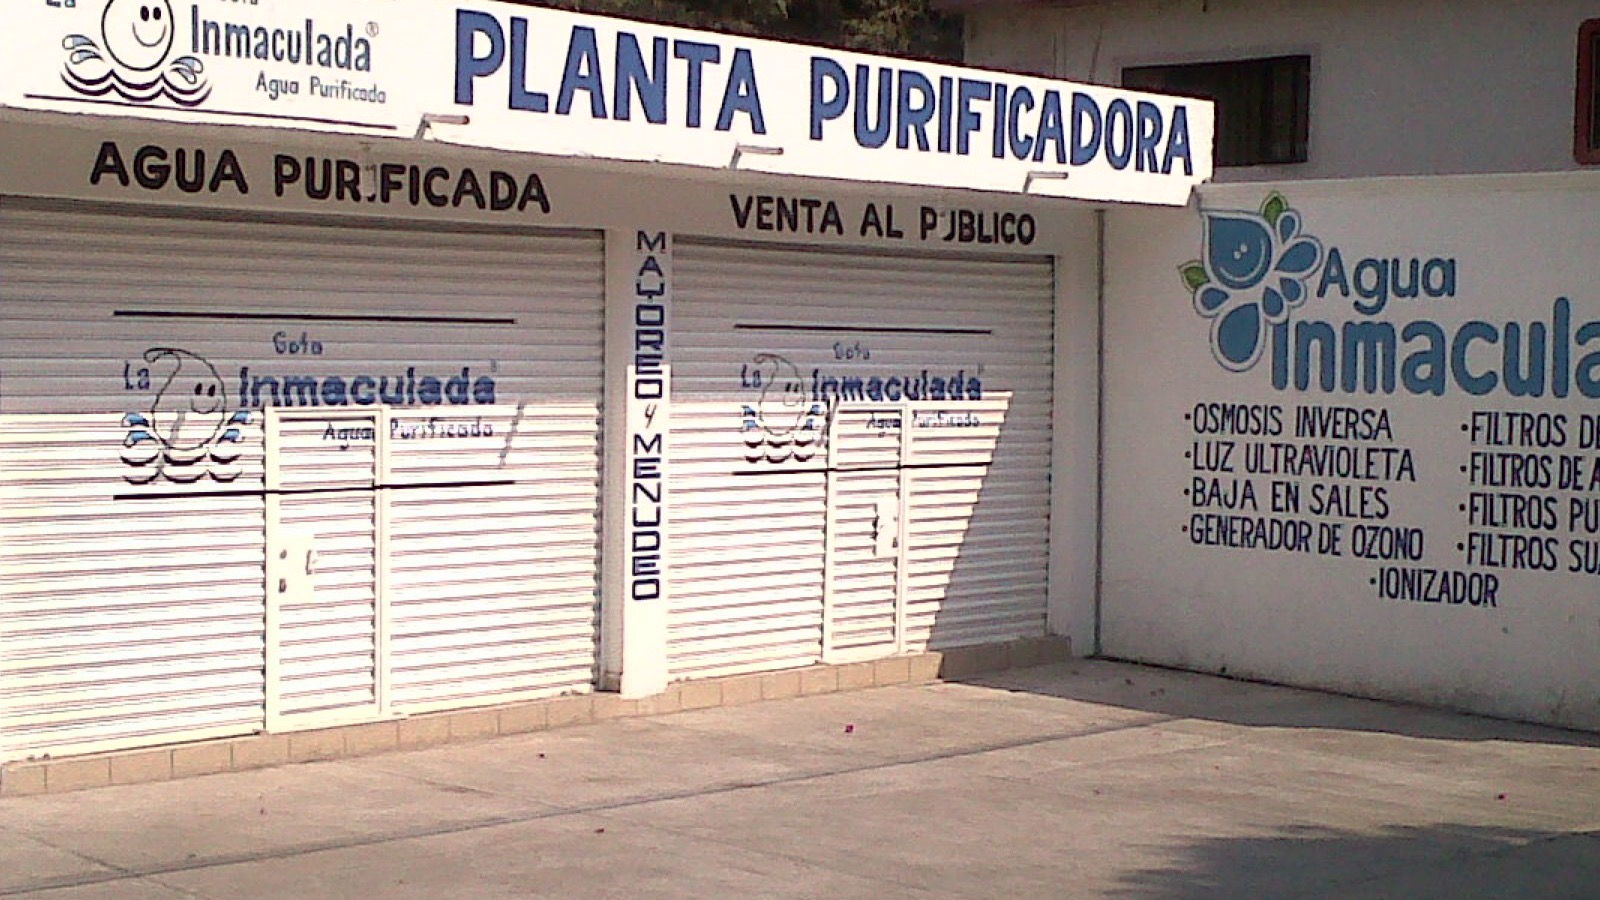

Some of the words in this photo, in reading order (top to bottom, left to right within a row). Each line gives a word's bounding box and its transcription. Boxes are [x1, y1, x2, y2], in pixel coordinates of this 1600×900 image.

[255, 70, 300, 100] Agua
[309, 76, 387, 104] Purificada
[454, 8, 767, 136] PLANTA
[810, 56, 1194, 176] PURIFICADORA
[91, 141, 248, 194] AGUA
[274, 154, 551, 213] PURFICADA
[730, 194, 844, 235] VENTA
[860, 202, 904, 238] AL
[1316, 247, 1456, 315] Agua
[634, 230, 667, 399] MAYOREO
[273, 331, 324, 355] Gota
[240, 366, 496, 408] Inmaculada
[811, 368, 982, 402] Inmaculada
[323, 422, 375, 449] Agua
[1193, 403, 1282, 437] OSMOSIS
[1296, 406, 1393, 442] INVERSA
[1472, 411, 1567, 447] FILTROS
[1580, 414, 1600, 449] D
[1193, 442, 1235, 473] LUZ
[1246, 443, 1415, 482] ULTRAVIOLETA
[1470, 452, 1552, 488] FILTROS
[1559, 454, 1584, 490] DE
[631, 433, 663, 601] MENUDEO
[1192, 477, 1257, 511] BAJA
[1271, 481, 1299, 513] EN
[1309, 484, 1389, 519] SALES
[1469, 492, 1558, 530] FILTROS
[1191, 514, 1312, 553] GENERADOR
[1318, 523, 1342, 556] DE
[1352, 525, 1423, 561] OZONO
[1467, 532, 1559, 571] FILTROS
[1568, 540, 1600, 575] SU
[1378, 567, 1499, 606] IONIZADOR
